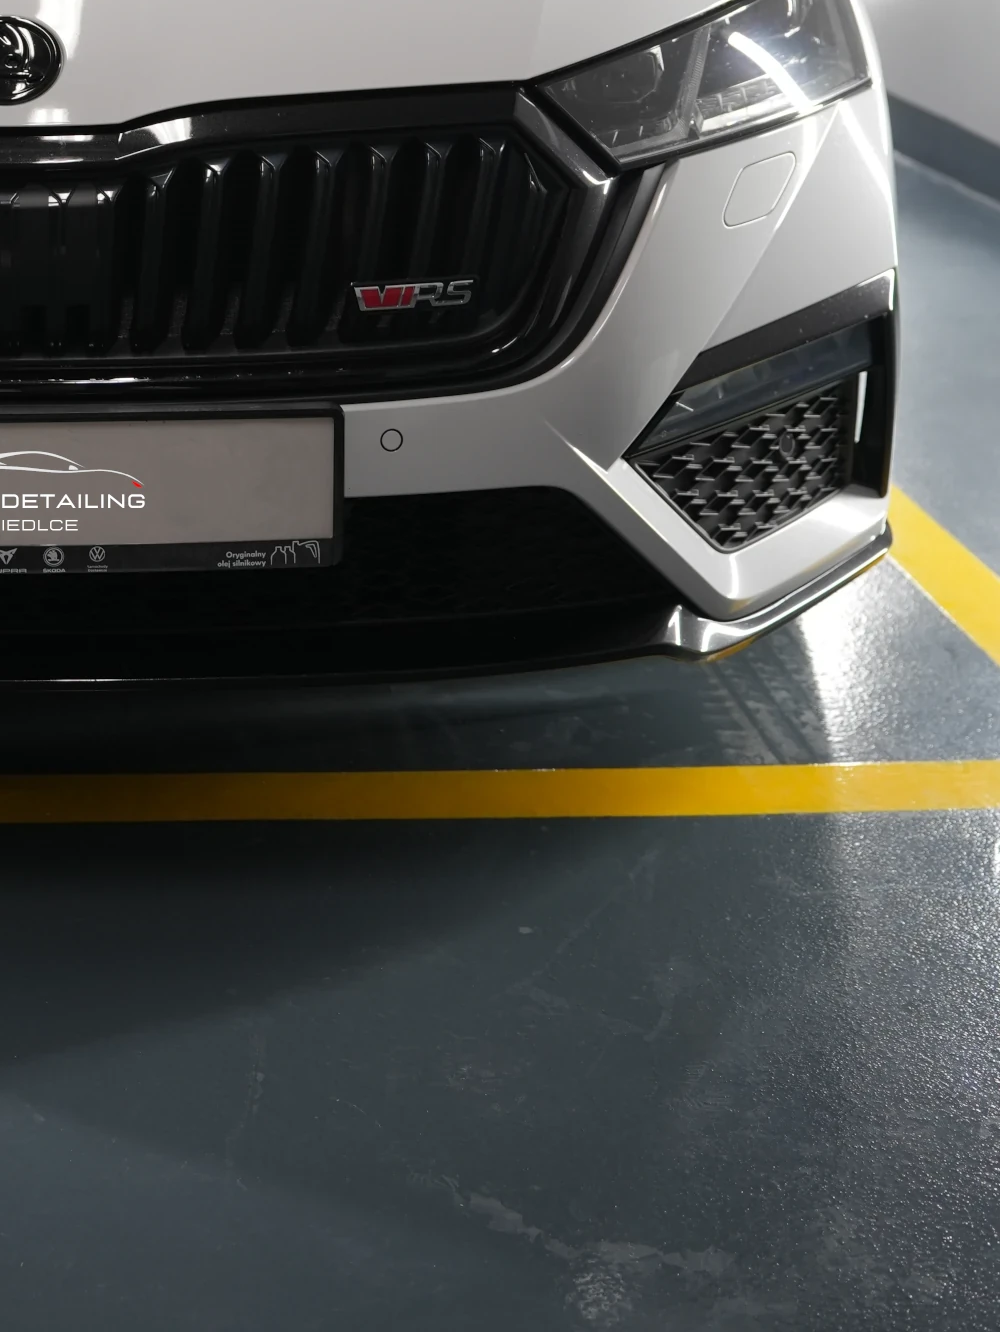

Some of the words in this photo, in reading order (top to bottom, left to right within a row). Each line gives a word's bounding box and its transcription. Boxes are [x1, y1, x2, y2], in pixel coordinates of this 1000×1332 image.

[226, 550, 266, 559] Oryginalny
[217, 559, 231, 568] olej
[233, 559, 266, 567] silnikowy
